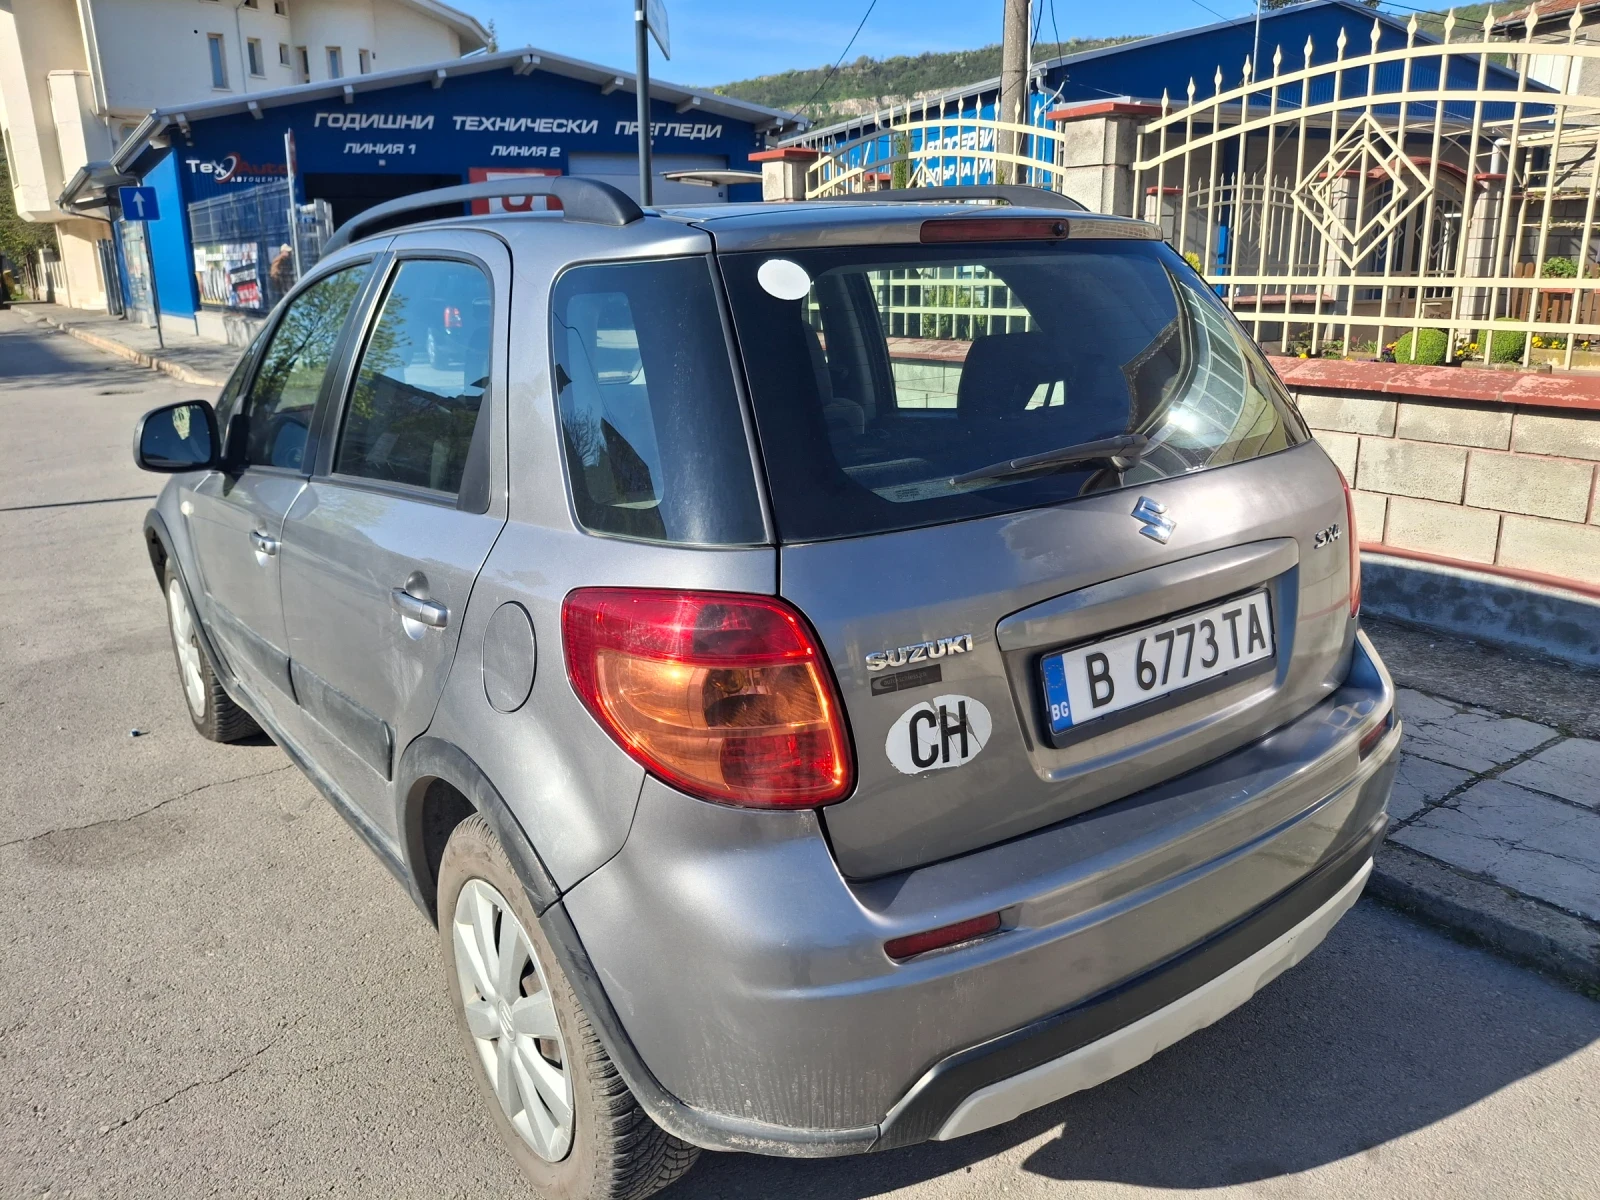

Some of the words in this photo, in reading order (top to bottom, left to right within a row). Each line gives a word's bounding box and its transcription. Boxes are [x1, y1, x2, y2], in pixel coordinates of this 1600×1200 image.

[313, 113, 435, 131] ГОДИШНИ
[452, 116, 599, 134] ТЕХНИЧЕСКИ
[343, 142, 405, 155] ЛИНИЯ
[408, 144, 416, 155] 1
[490, 145, 547, 158] ЛИНИЯ
[549, 147, 561, 158] 2
[1313, 523, 1342, 550] SX4
[865, 633, 974, 672] SUZUKI
[1085, 652, 1115, 709] B
[1135, 618, 1219, 691] 6773
[1222, 603, 1267, 661] TA
[1051, 701, 1070, 722] BG
[908, 700, 969, 769] CH
